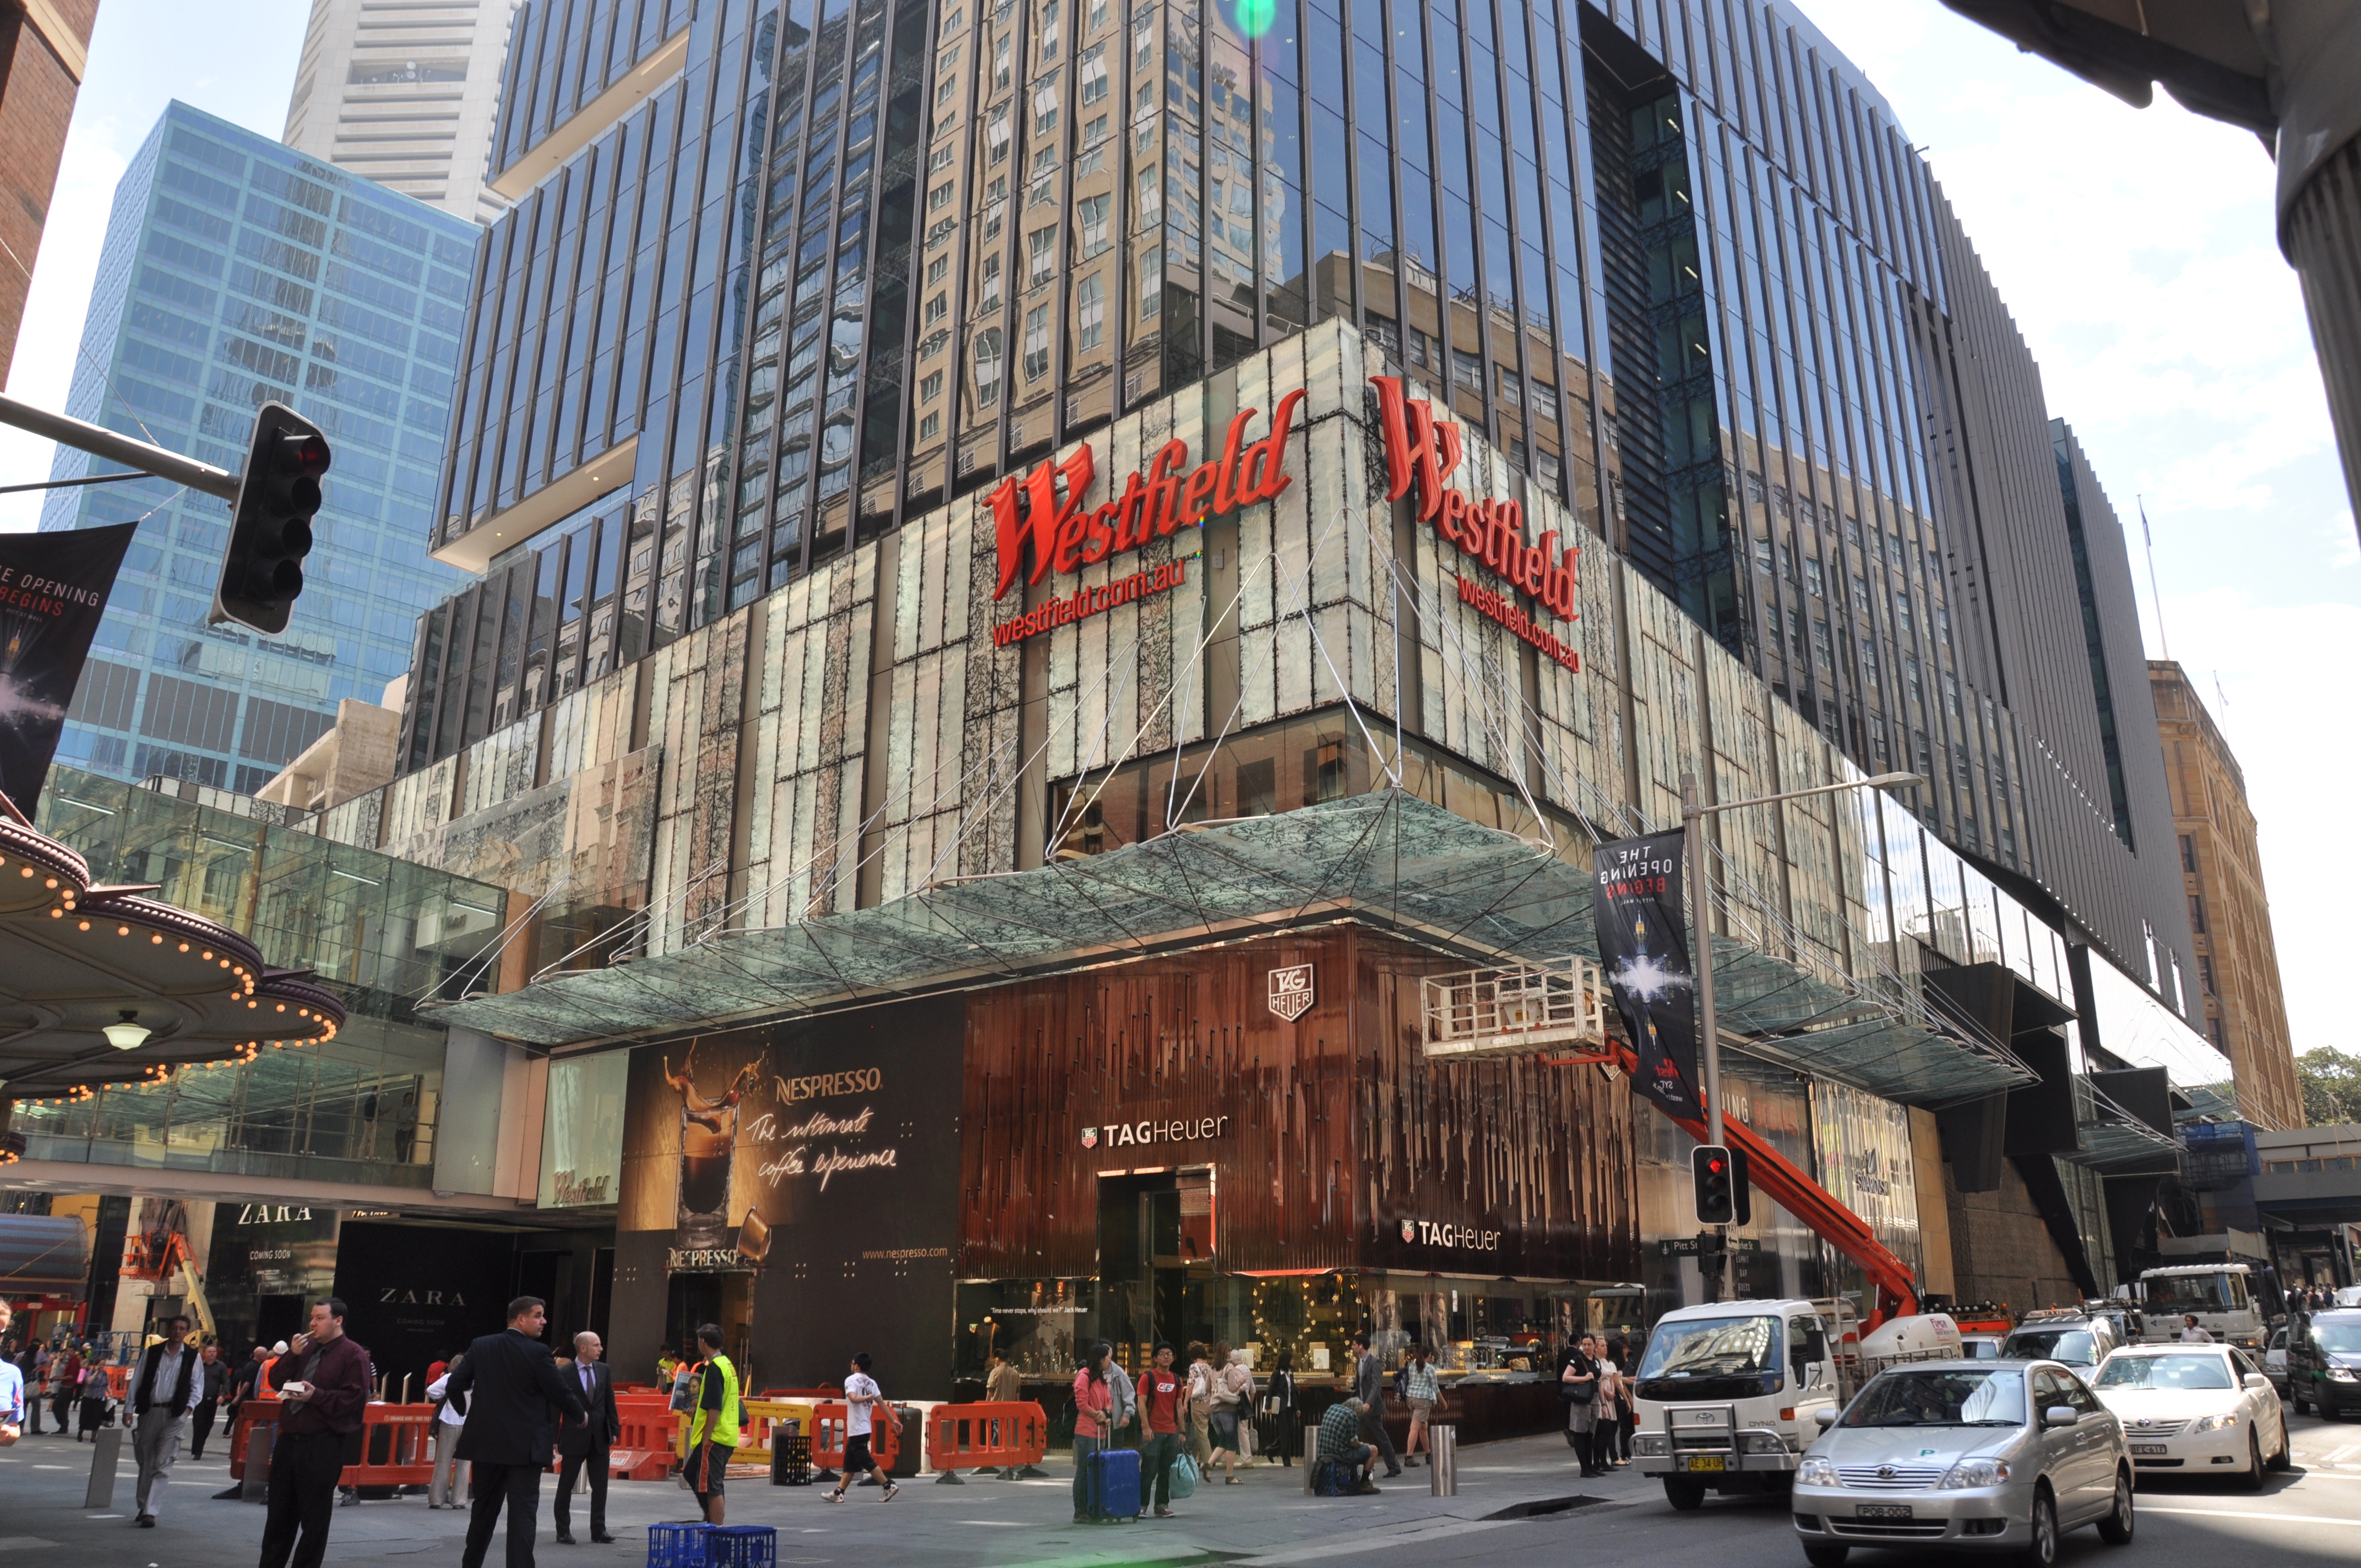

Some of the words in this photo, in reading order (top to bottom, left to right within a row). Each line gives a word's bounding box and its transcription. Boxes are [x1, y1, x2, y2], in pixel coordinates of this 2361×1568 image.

[982, 388, 1308, 601] Westfield
[1368, 376, 1581, 623] Westfield
[0, 586, 64, 616] BEGINS
[20, 574, 99, 606] OPENING
[993, 559, 1185, 646] westfield.com.au
[1457, 575, 1580, 674] westfield.com.au
[1276, 969, 1306, 993] TAG
[1272, 993, 1310, 1017] HEUER
[774, 1068, 881, 1106] NESPRESSO
[746, 1114, 775, 1141] The
[781, 1107, 874, 1138] ultimate
[758, 1147, 805, 1188] coffee
[811, 1146, 896, 1192] experience
[552, 1169, 610, 1205] Westfield
[238, 1203, 312, 1224] ZARA
[250, 1250, 273, 1260] COMING
[274, 1249, 291, 1259] SOON
[862, 1246, 948, 1260] www.nespresso.com
[1674, 1242, 1688, 1250] Pitt
[380, 1288, 467, 1306] ZARA
[1738, 1283, 1750, 1292] GUESS
[1690, 1458, 1700, 1468] AE
